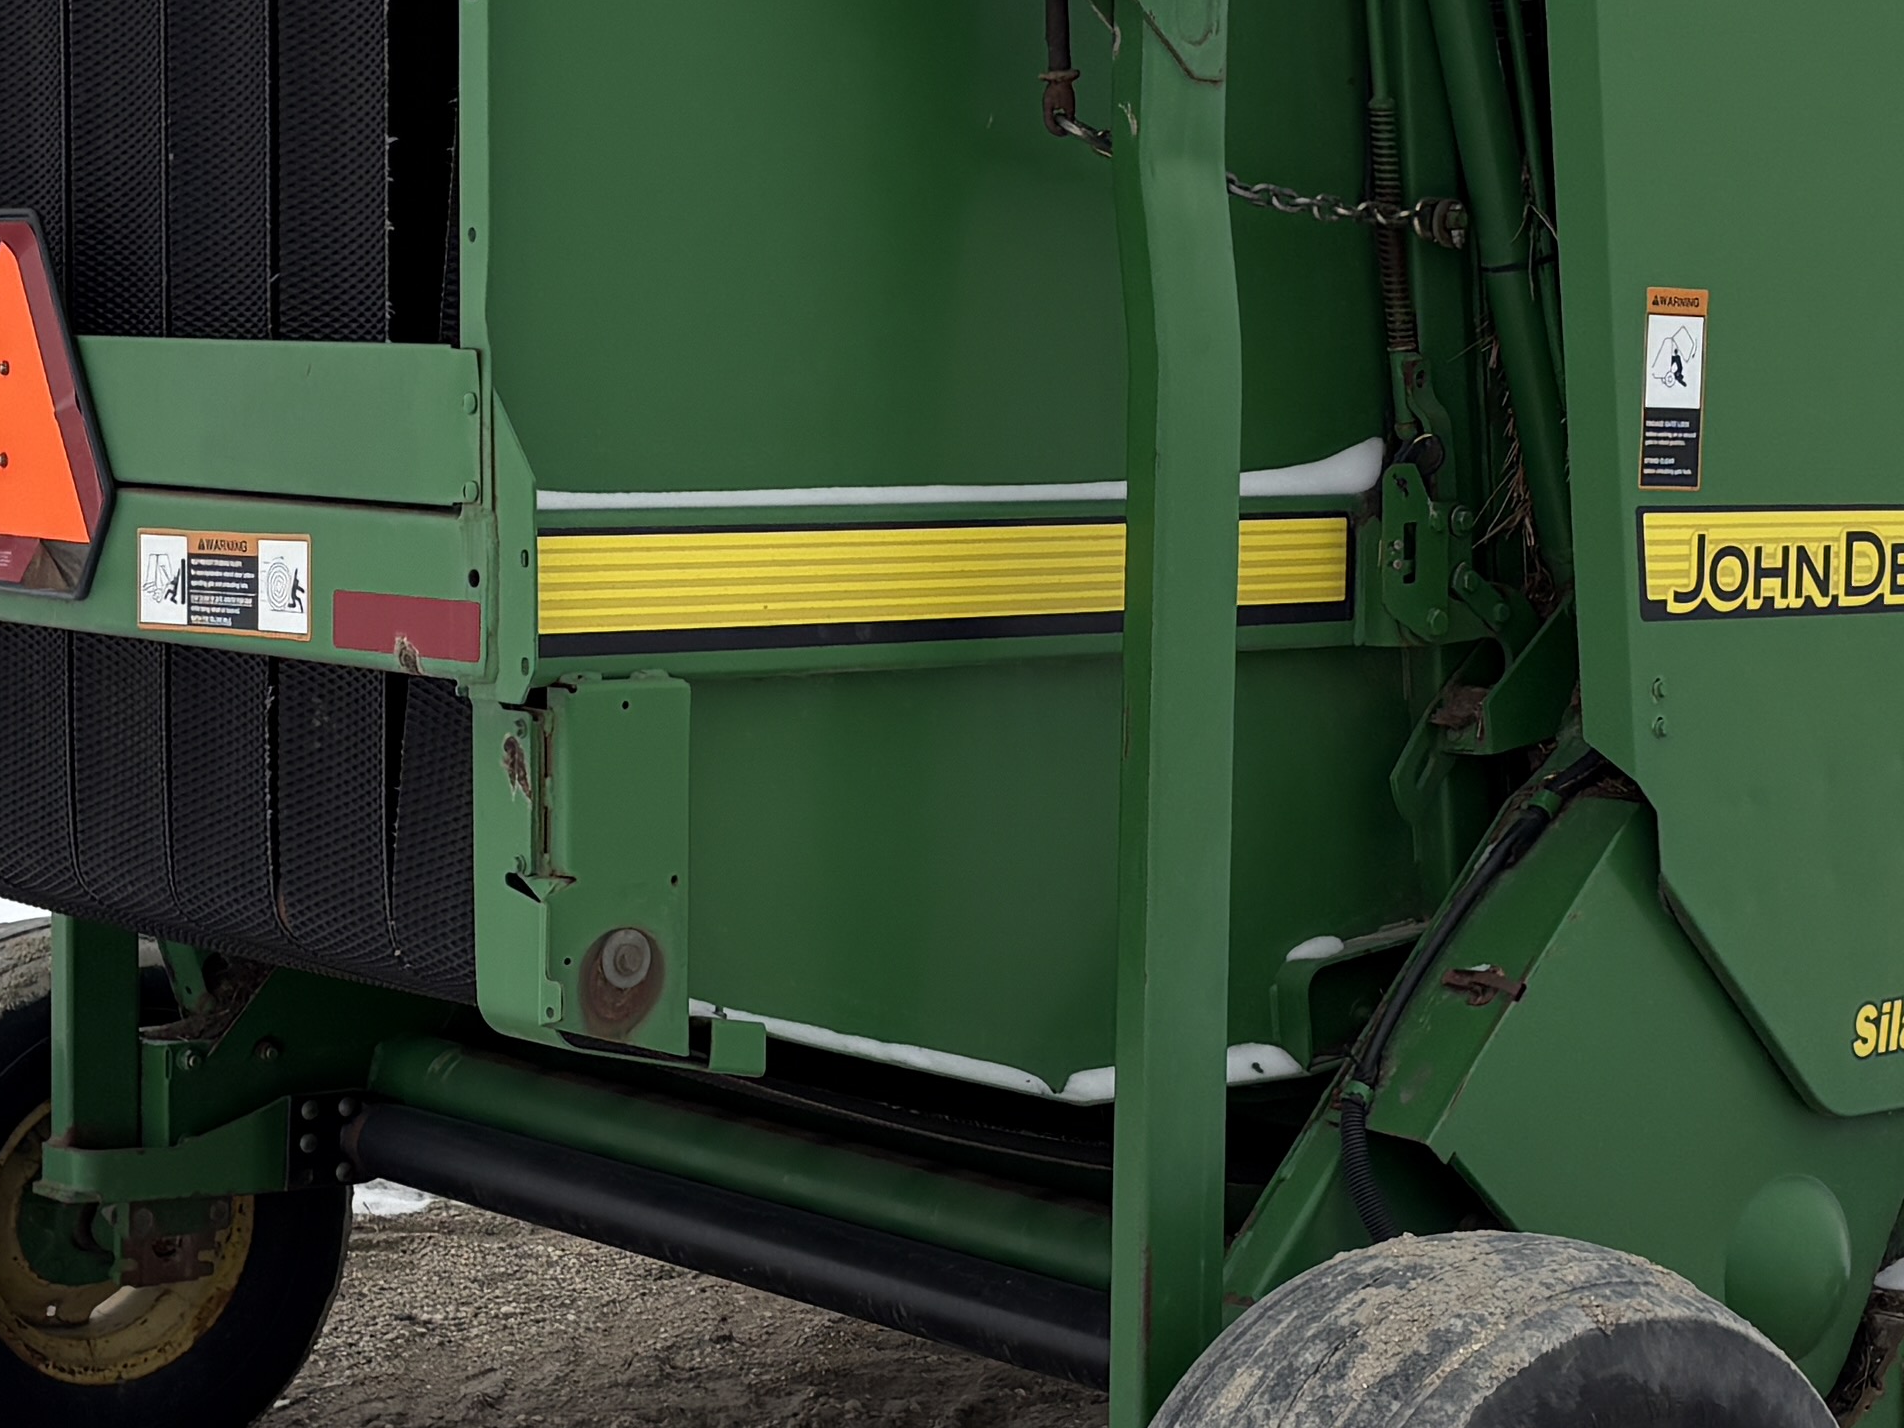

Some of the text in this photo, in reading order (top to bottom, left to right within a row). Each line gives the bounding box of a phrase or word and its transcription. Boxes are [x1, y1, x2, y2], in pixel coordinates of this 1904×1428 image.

[1659, 295, 1700, 308] WARNING
[205, 538, 248, 553] WARNING
[1669, 532, 1833, 608] JOHN
